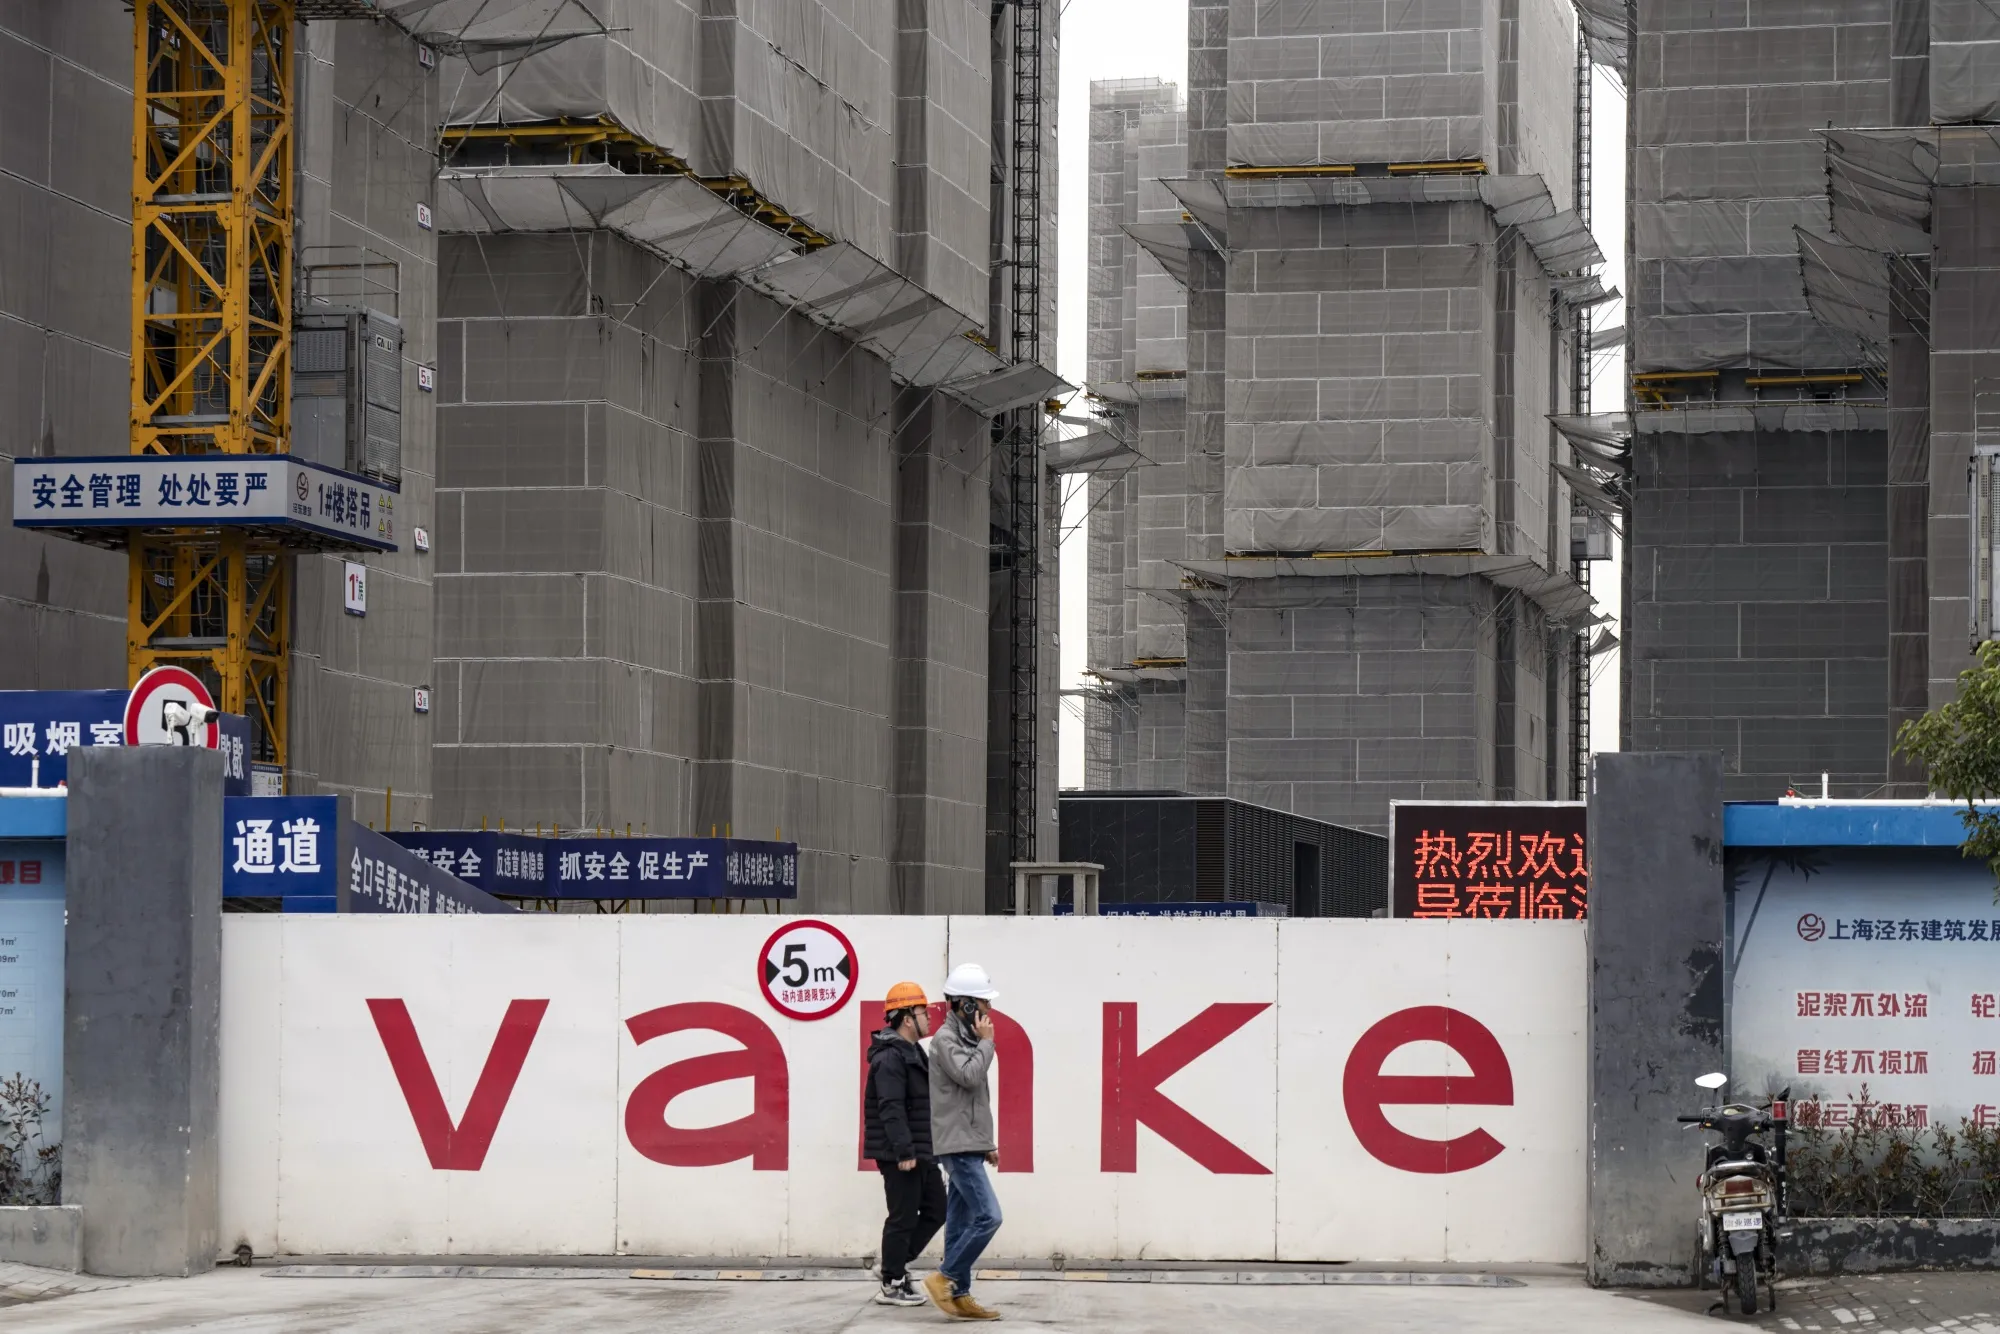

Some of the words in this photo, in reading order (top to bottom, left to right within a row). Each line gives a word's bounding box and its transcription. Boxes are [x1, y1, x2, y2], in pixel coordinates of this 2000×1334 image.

[32, 473, 142, 509] 安全管理
[158, 472, 268, 507] 处处要严
[319, 482, 370, 531] 1#楼塔吊
[3, 720, 123, 756] 吸烟室
[232, 817, 321, 874] 通道
[560, 851, 630, 881] 抓安全
[637, 850, 709, 881] 促生产
[782, 987, 837, 1003] 场内道路限宽5米
[1797, 993, 1928, 1018] 泥浆不外流
[1971, 993, 2000, 1018] 轮
[1797, 1049, 1929, 1075] 管线不损坏
[1973, 1051, 2000, 1075] 扬
[366, 998, 1515, 1176] vanke
[1973, 1104, 2000, 1127] 作
